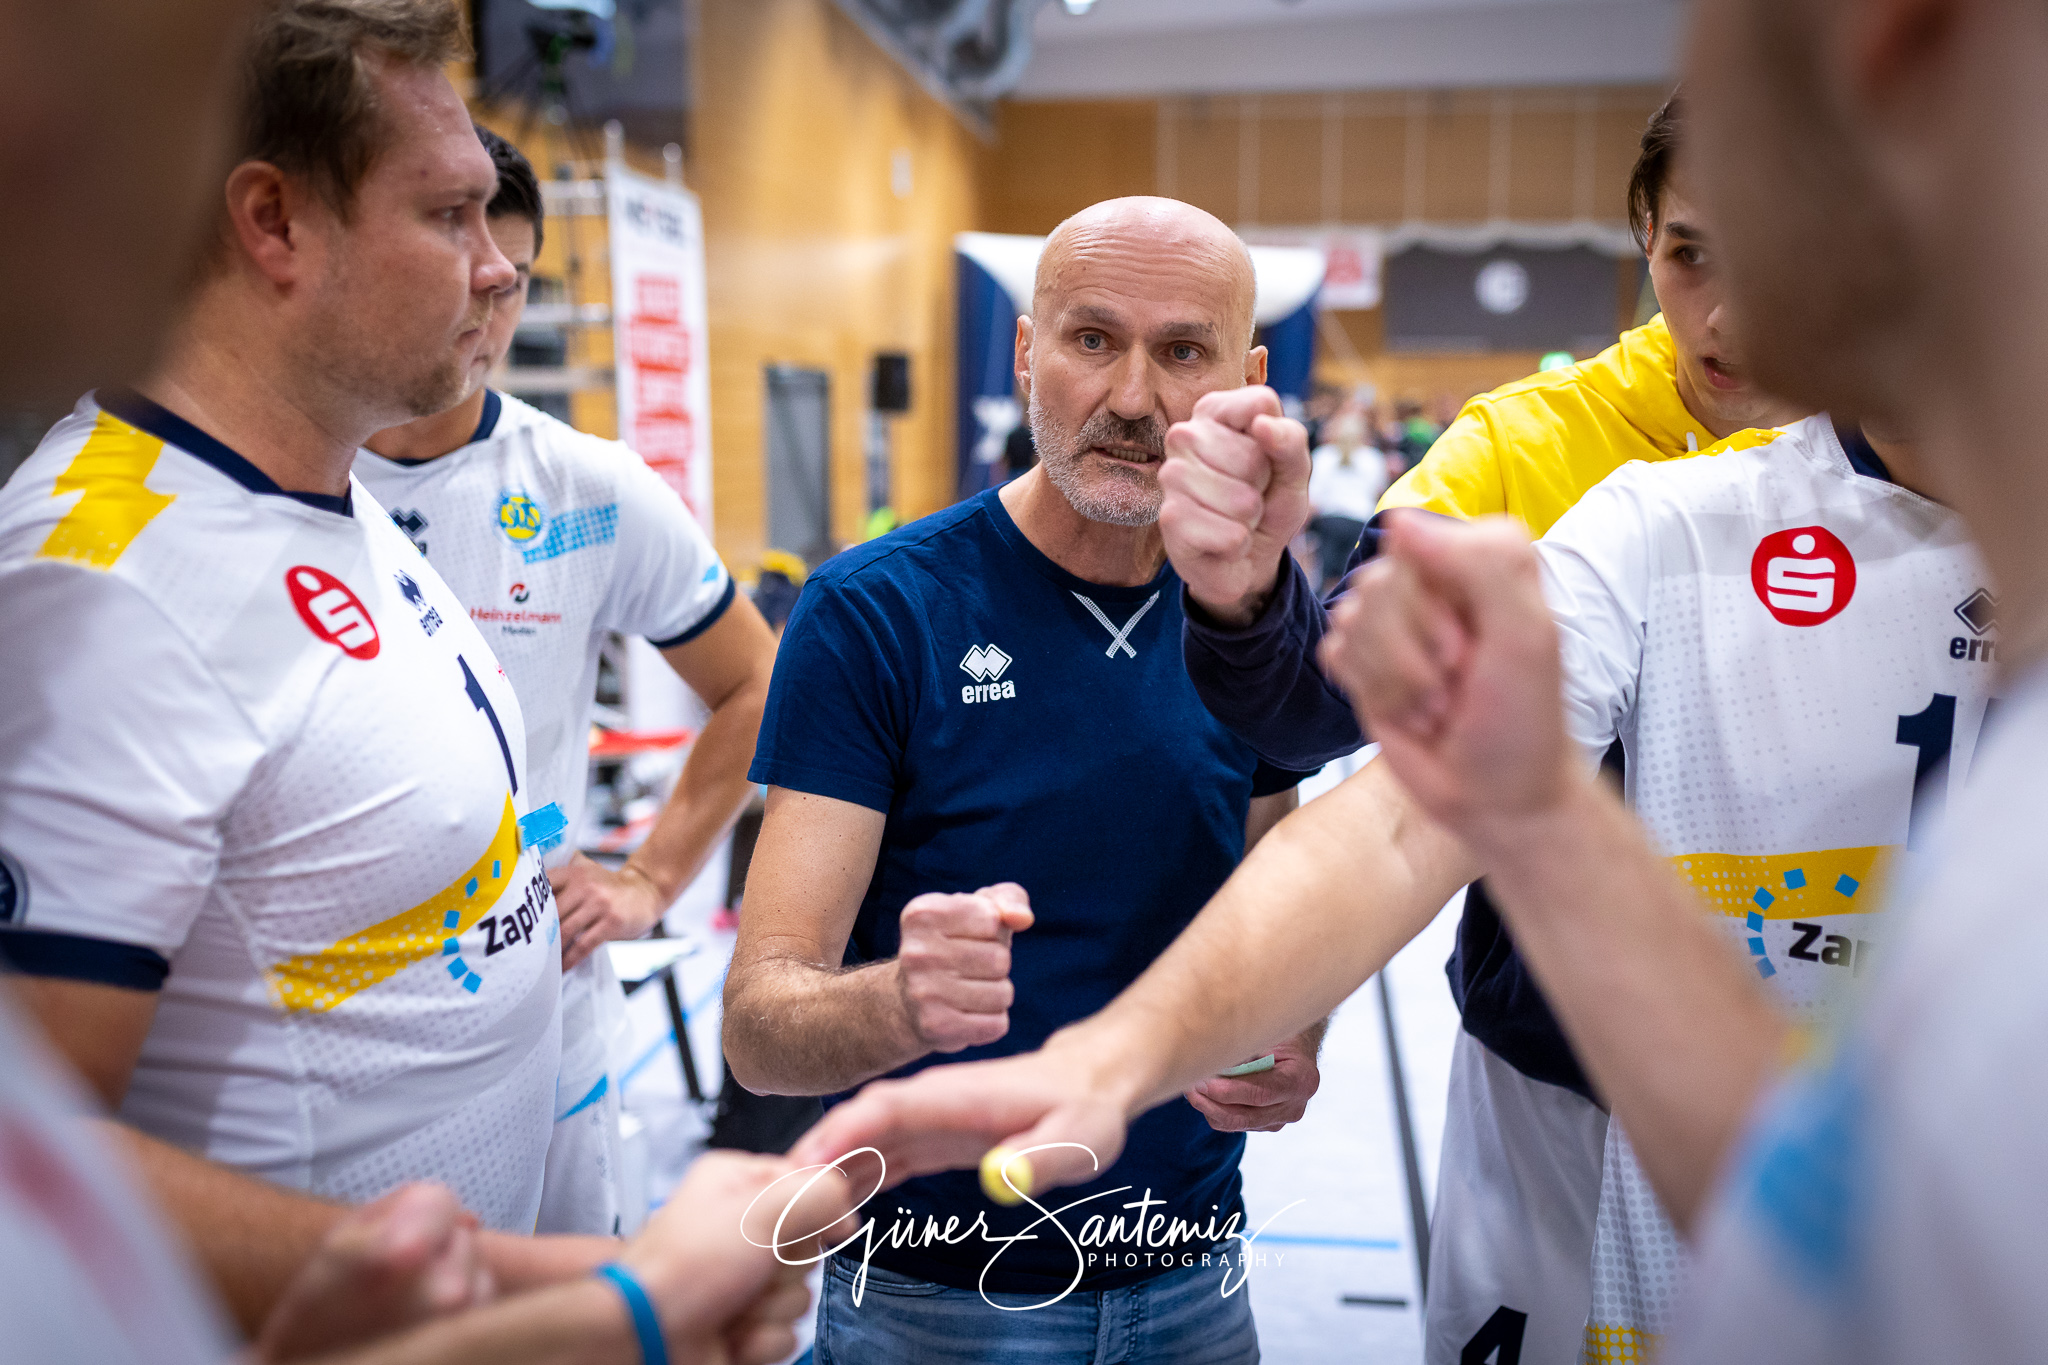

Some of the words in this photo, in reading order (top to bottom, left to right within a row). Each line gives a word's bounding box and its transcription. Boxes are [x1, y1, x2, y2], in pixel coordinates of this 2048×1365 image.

[470, 605, 562, 624] Heinzelmann
[1949, 636, 2000, 662] err
[477, 886, 539, 957] Zapf
